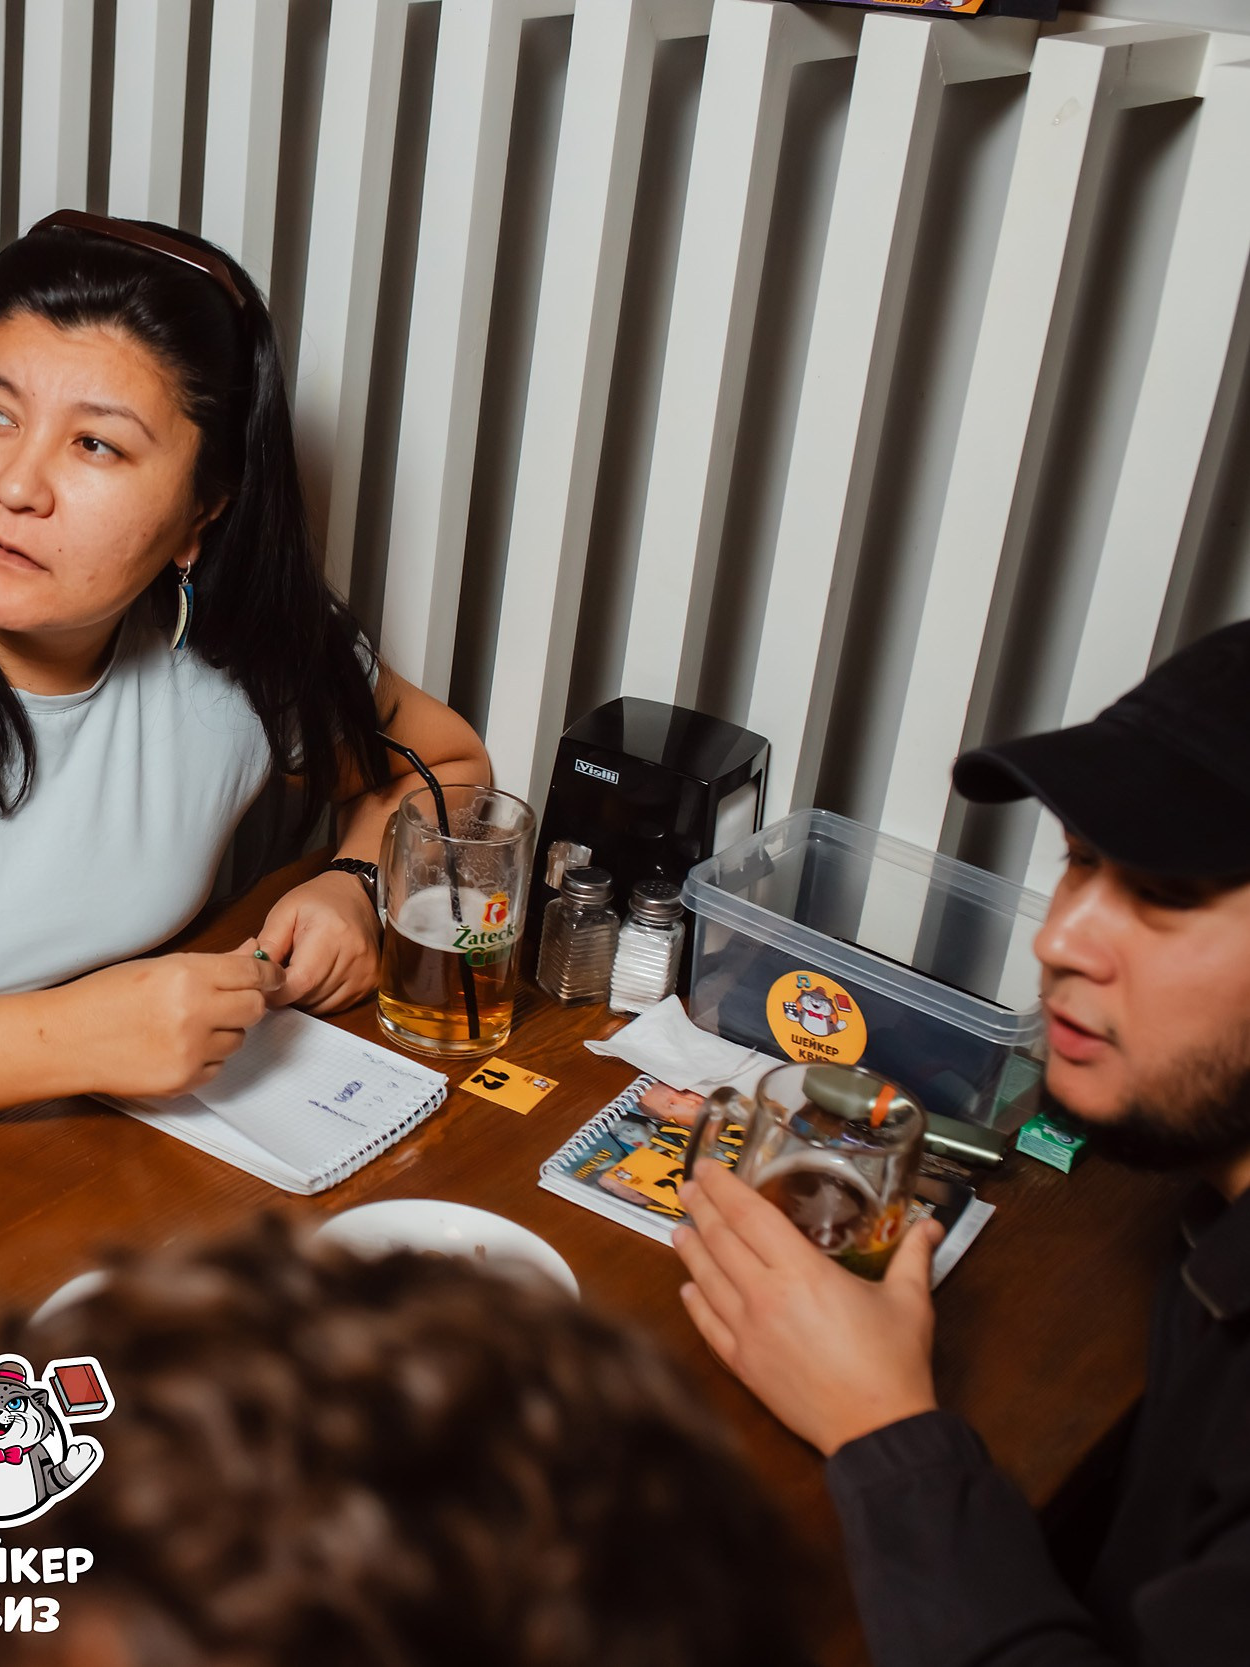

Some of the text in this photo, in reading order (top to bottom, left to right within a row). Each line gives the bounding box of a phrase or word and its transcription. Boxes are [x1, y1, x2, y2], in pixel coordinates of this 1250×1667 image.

[453, 924, 515, 950] Žateck
[791, 1033, 839, 1057] ШЕЙКЕР
[470, 1068, 510, 1090] 12
